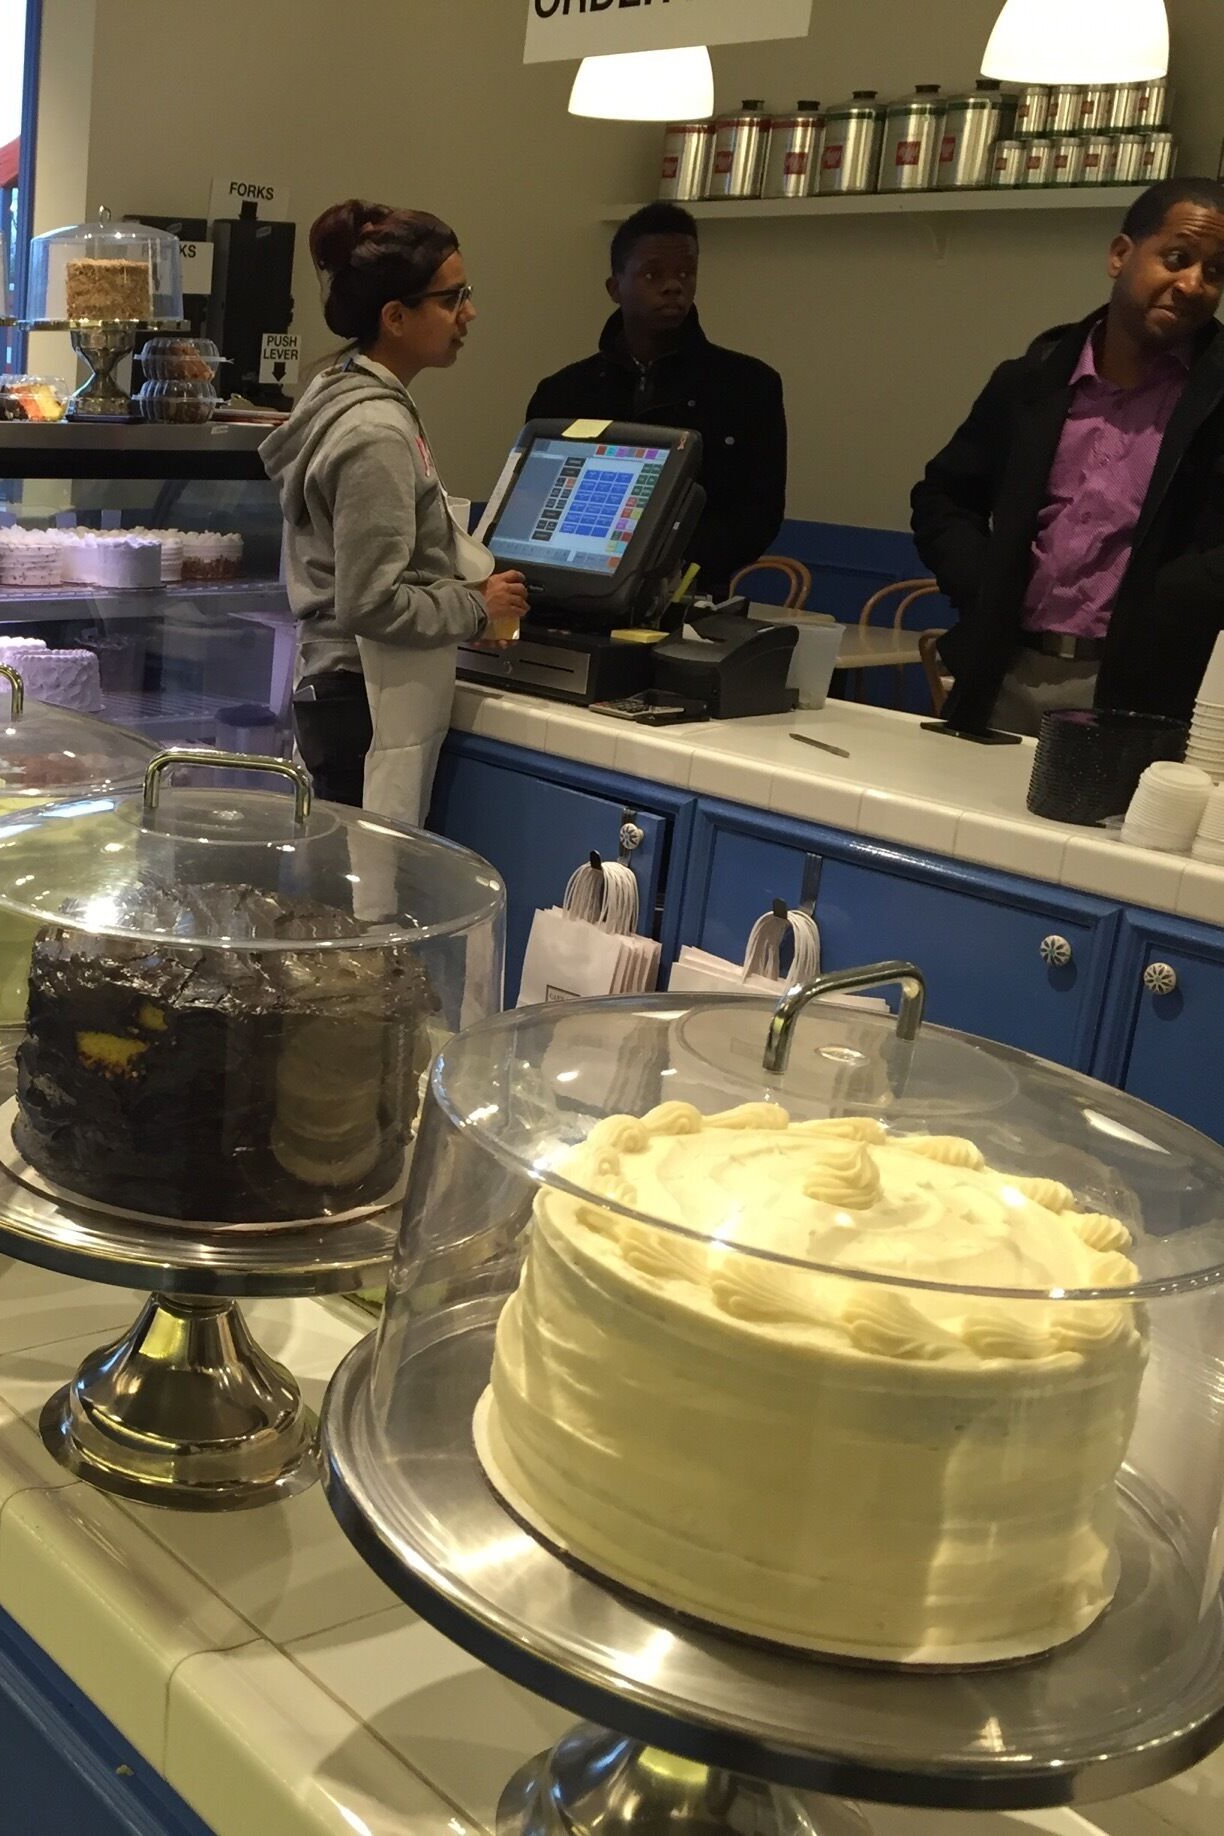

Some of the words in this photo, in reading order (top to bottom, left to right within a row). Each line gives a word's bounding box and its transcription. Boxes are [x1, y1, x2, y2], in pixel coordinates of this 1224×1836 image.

[229, 181, 274, 201] FORKS
[266, 335, 298, 347] PUSH
[263, 348, 299, 360] LEVER
